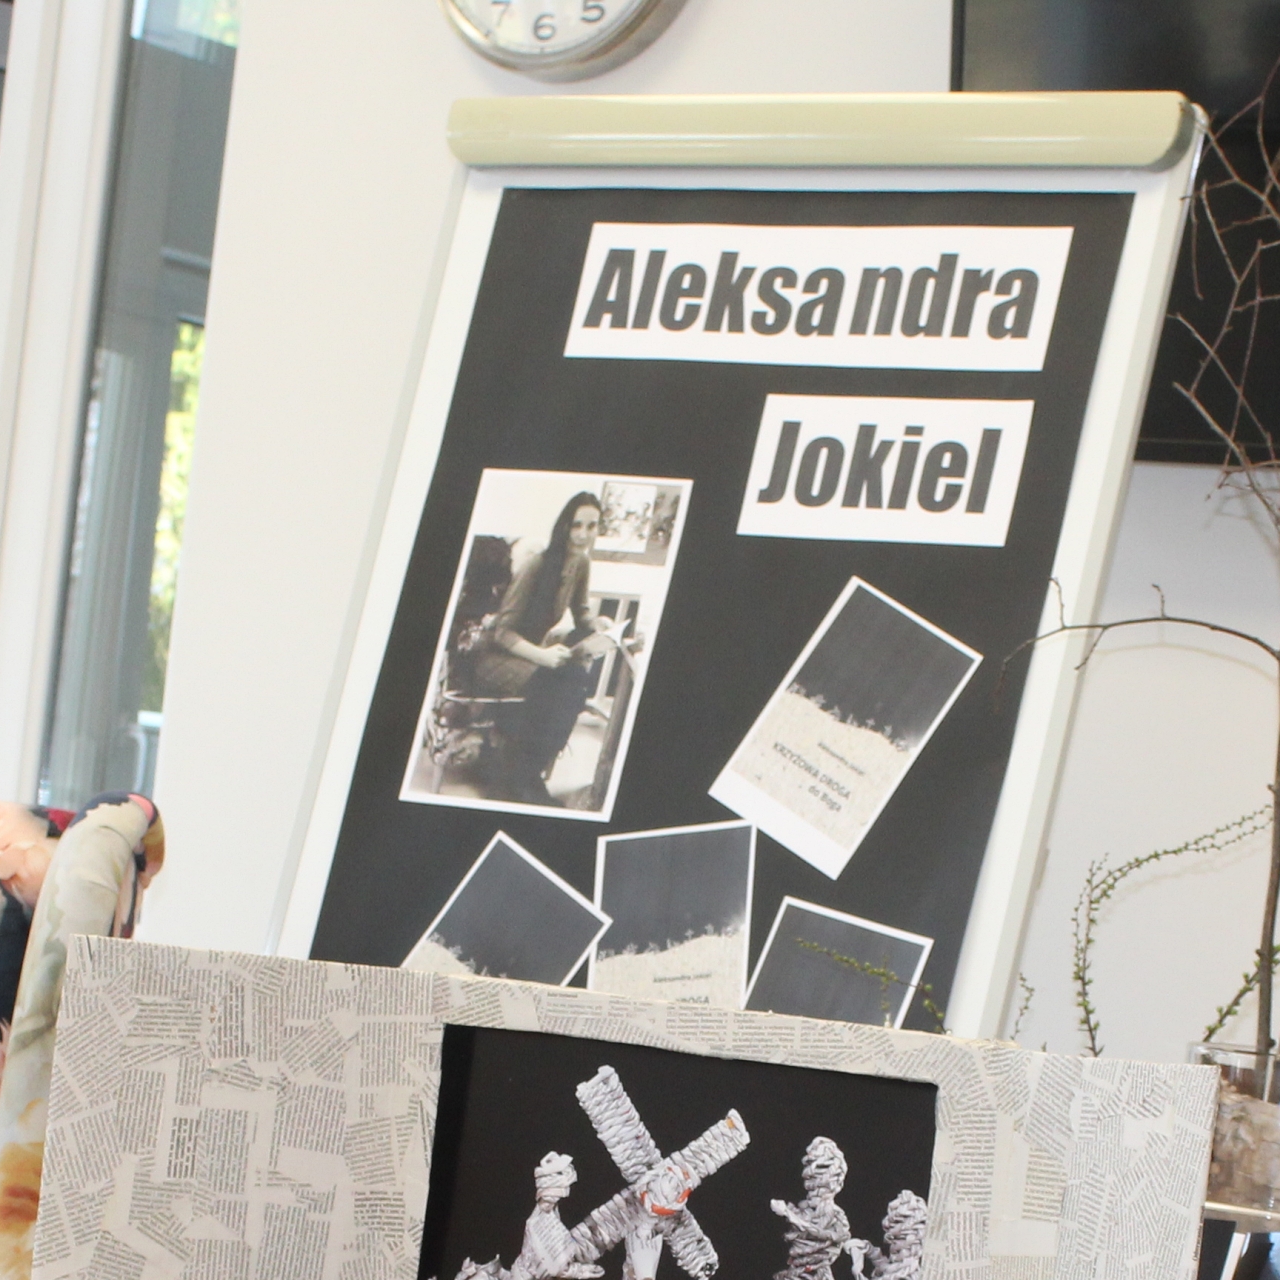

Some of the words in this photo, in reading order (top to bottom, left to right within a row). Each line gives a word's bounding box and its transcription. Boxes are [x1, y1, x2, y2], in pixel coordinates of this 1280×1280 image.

[533, 12, 556, 41] 6
[580, 0, 606, 23] 5
[581, 247, 1041, 341] Aleksandra
[757, 419, 1004, 516] Jokiel
